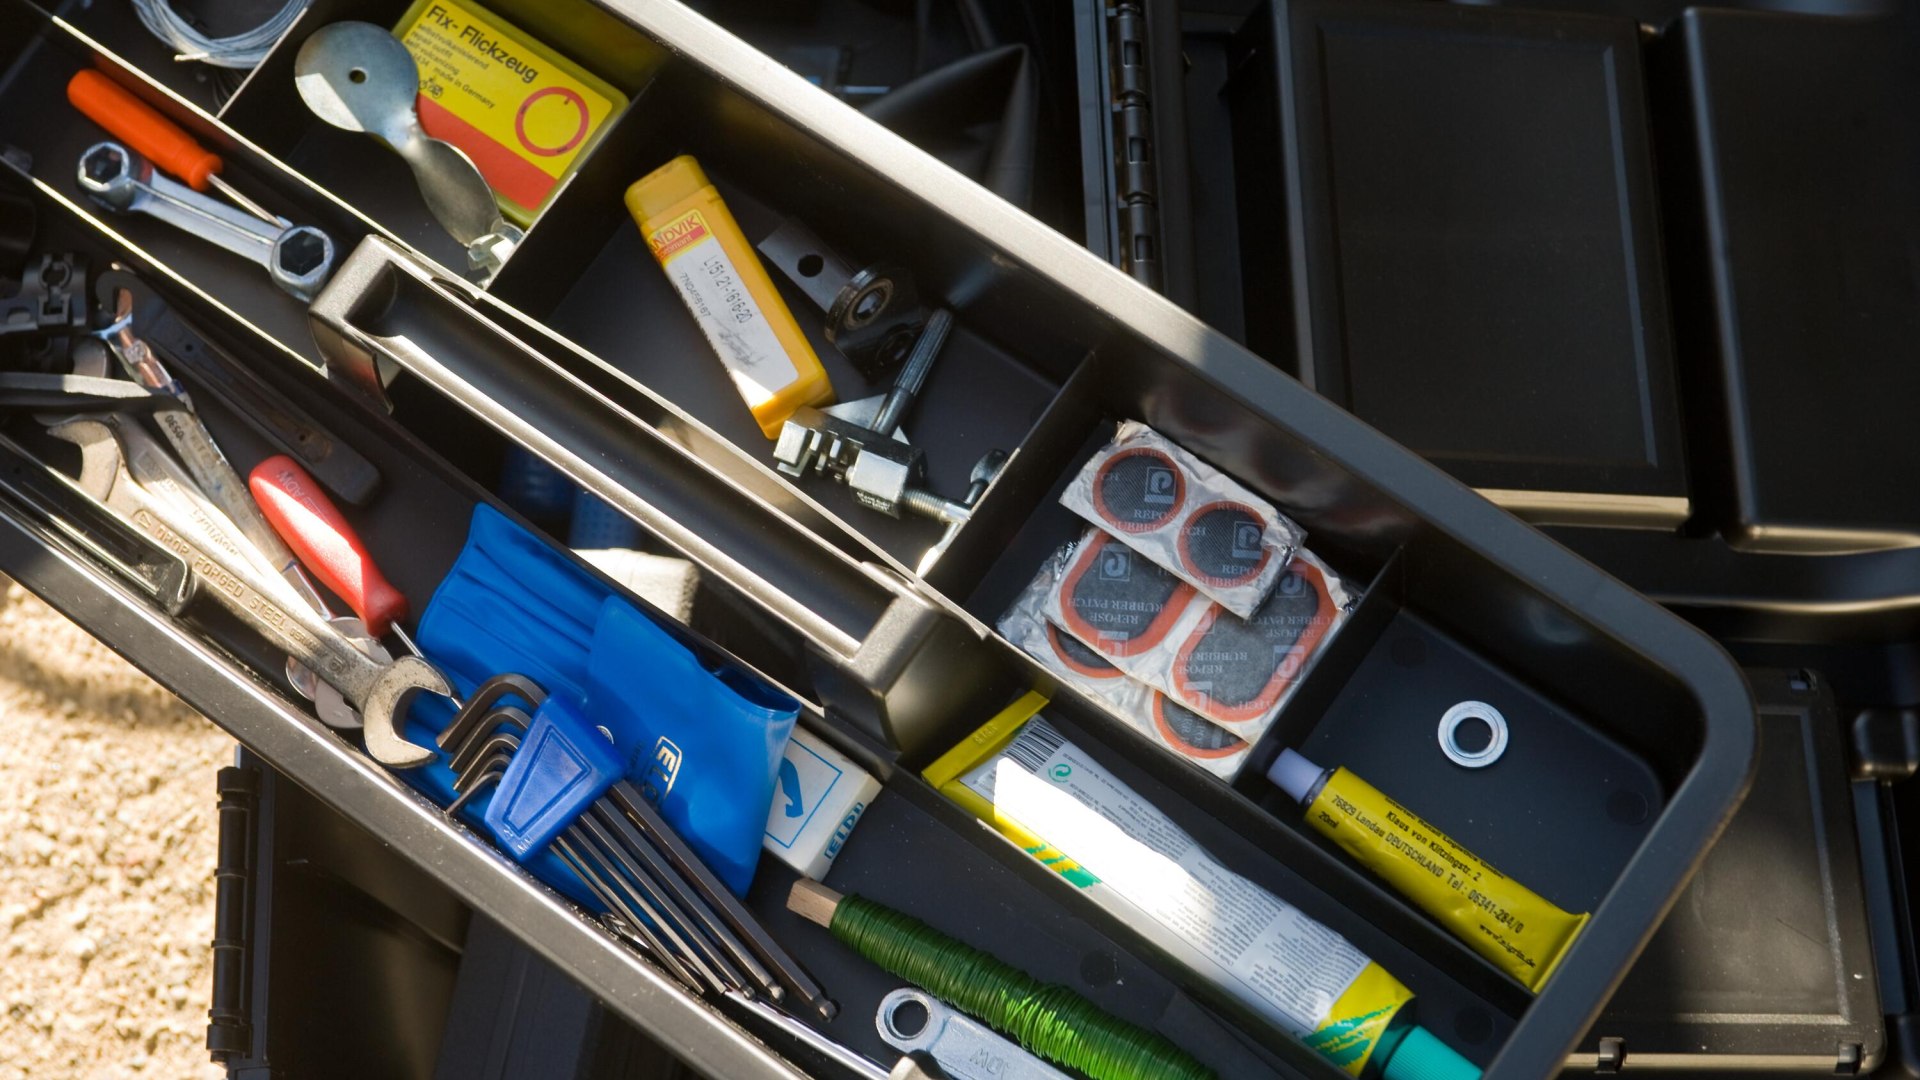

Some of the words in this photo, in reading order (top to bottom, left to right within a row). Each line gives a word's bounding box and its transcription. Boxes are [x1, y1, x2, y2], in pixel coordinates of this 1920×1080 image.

[426, 5, 459, 30] Fix-
[460, 25, 539, 84] Flickzeug
[434, 67, 454, 84] made
[462, 84, 495, 110] Germany
[155, 527, 190, 554] DROP
[194, 556, 244, 598] FORGED
[249, 596, 287, 631] STEEL
[1067, 597, 1110, 608] PATCH
[1112, 599, 1163, 613] RUBBER
[1089, 612, 1139, 625] REPOSE
[1196, 652, 1248, 661] RUBBER
[1176, 665, 1223, 674] REPOSE
[1318, 810, 1340, 829] 20ml
[1386, 811, 1409, 833] Klaus
[1411, 830, 1428, 844] von
[1428, 842, 1471, 876] Klitzingstr.
[1473, 872, 1482, 882] 2
[1331, 795, 1357, 816] 76829
[1355, 811, 1386, 838] Landau
[1385, 832, 1445, 878] DEUTSCHLAND
[1468, 889, 1524, 934] 06341-284/0
